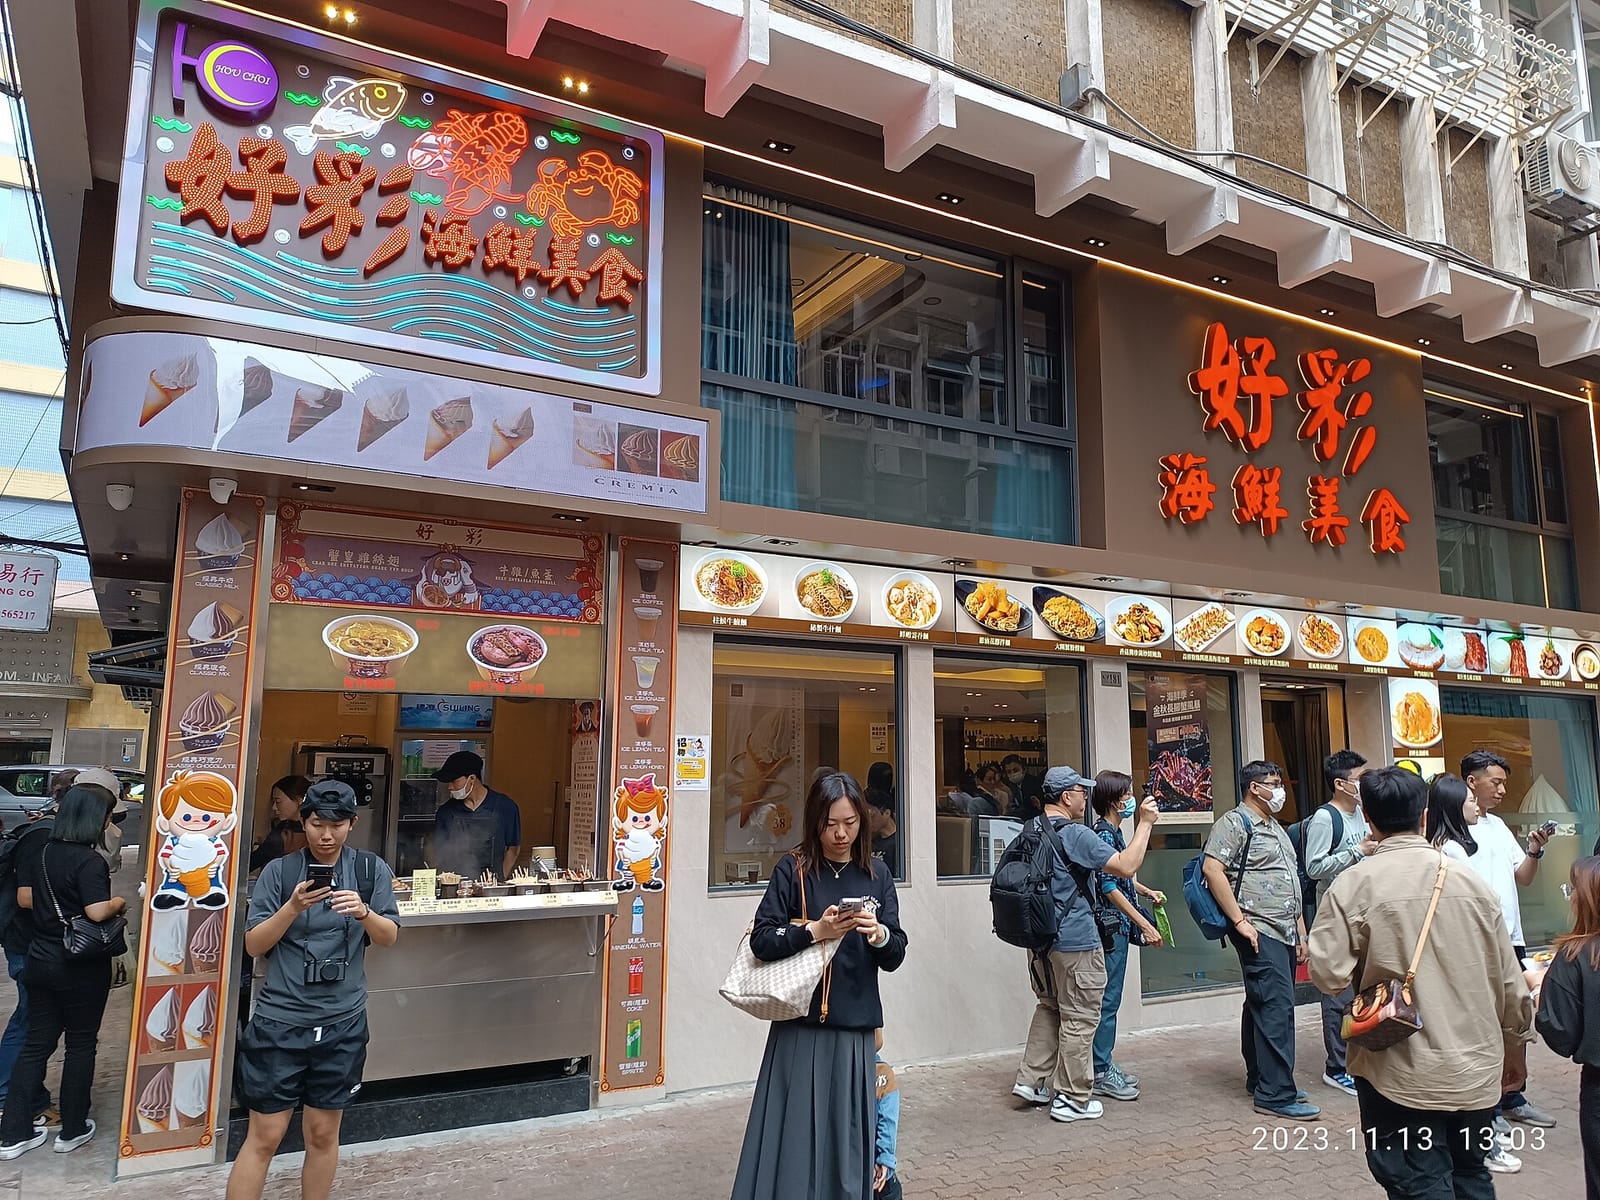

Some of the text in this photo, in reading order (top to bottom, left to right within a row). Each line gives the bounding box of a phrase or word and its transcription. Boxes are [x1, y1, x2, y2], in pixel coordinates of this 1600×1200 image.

[242, 72, 271, 85] CHOI
[165, 121, 416, 279] 好彩
[421, 209, 646, 305] 海鮮美食
[1187, 321, 1377, 477] 好彩
[415, 522, 483, 546] 好彩
[594, 477, 678, 495] CREMIA
[1157, 452, 1412, 554] 海鮮美食
